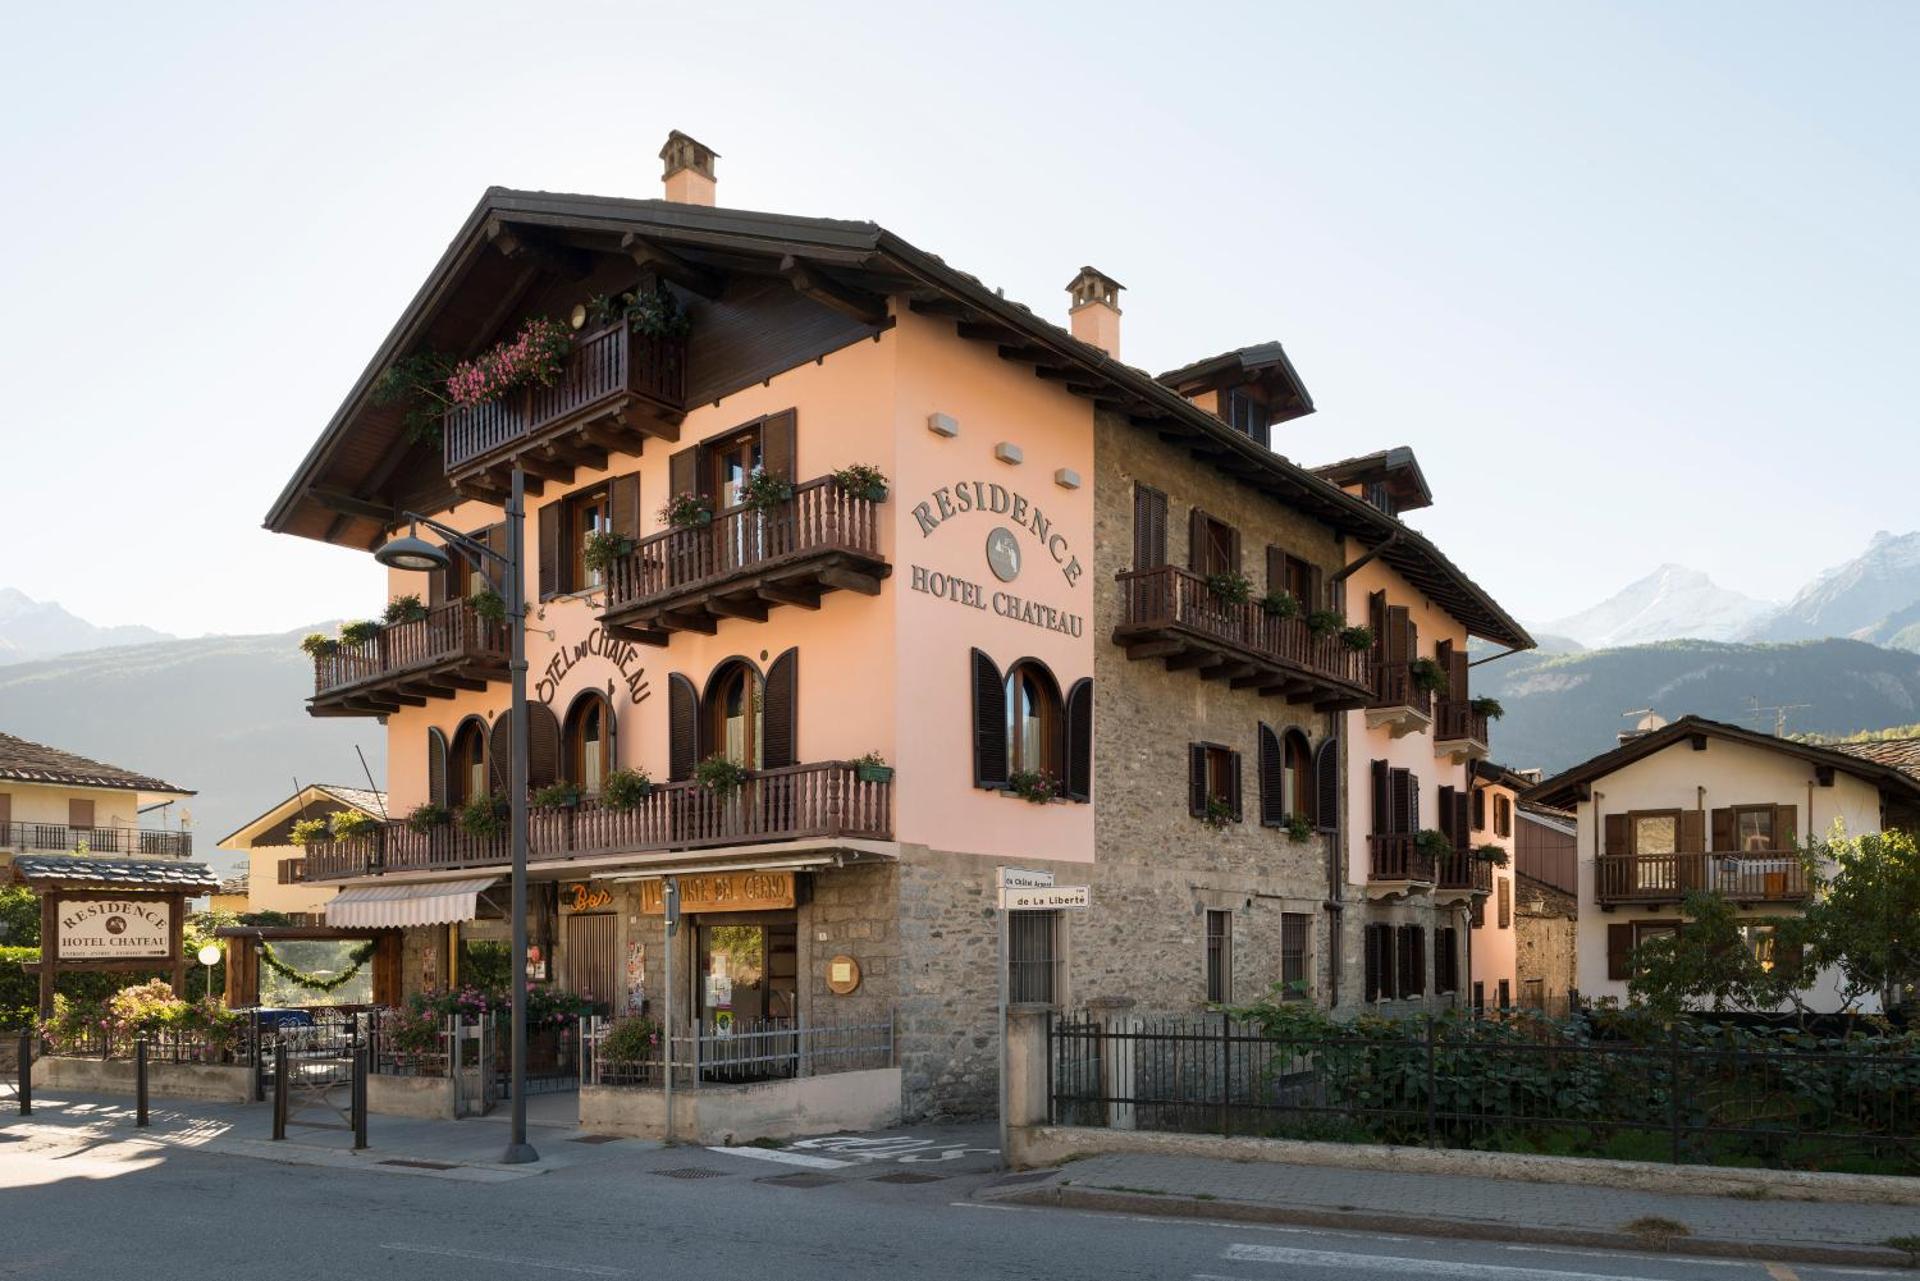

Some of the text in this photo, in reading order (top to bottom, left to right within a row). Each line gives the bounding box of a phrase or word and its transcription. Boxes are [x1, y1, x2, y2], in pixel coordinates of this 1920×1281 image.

[911, 481, 1083, 589] RESIDENCE
[911, 564, 1083, 639] HOTEL CHATEAU
[535, 645, 576, 705] ÔTEL
[571, 884, 613, 911] Bar
[1017, 895, 1085, 906] de La Liberté
[63, 903, 167, 930] RESIDENCE
[62, 937, 167, 947] HOTEL CHATEAU
